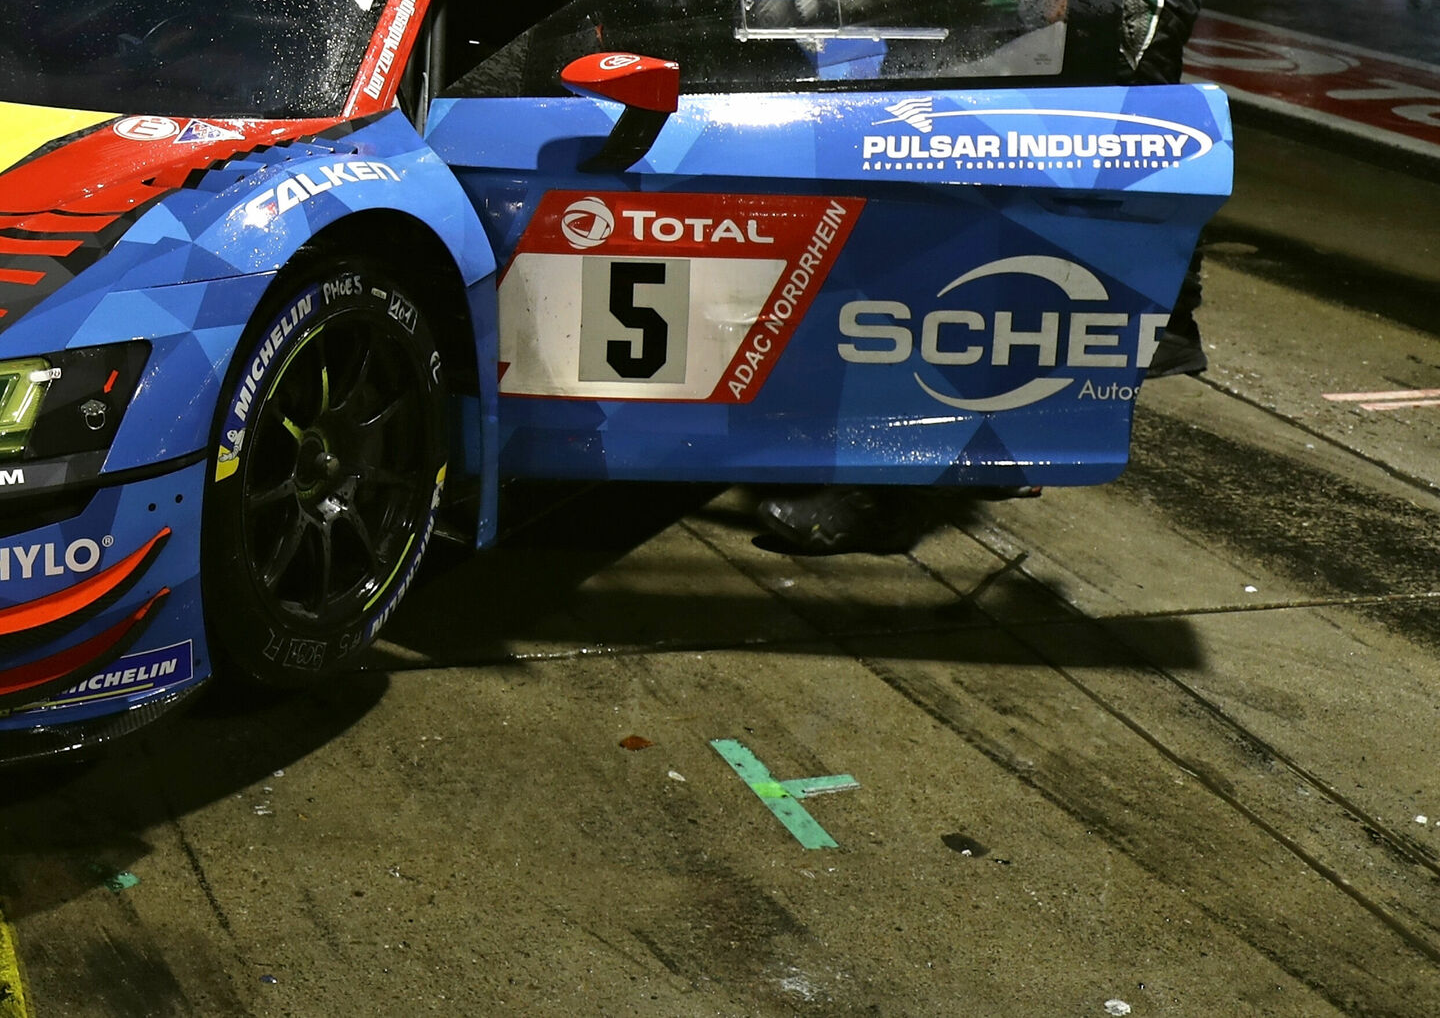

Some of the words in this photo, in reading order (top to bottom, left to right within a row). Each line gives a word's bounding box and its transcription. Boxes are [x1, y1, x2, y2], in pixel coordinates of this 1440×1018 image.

[862, 134, 1001, 159] PULSAR
[1006, 131, 1189, 159] INDUSTRY
[242, 160, 401, 229] FALKEN
[622, 209, 775, 245] TOTAL
[605, 261, 669, 380] 5
[727, 334, 773, 401] ADAC
[766, 199, 848, 341] NORDRHEIN
[233, 292, 315, 423] MICHELIN
[60, 657, 179, 695] ICHELIN
